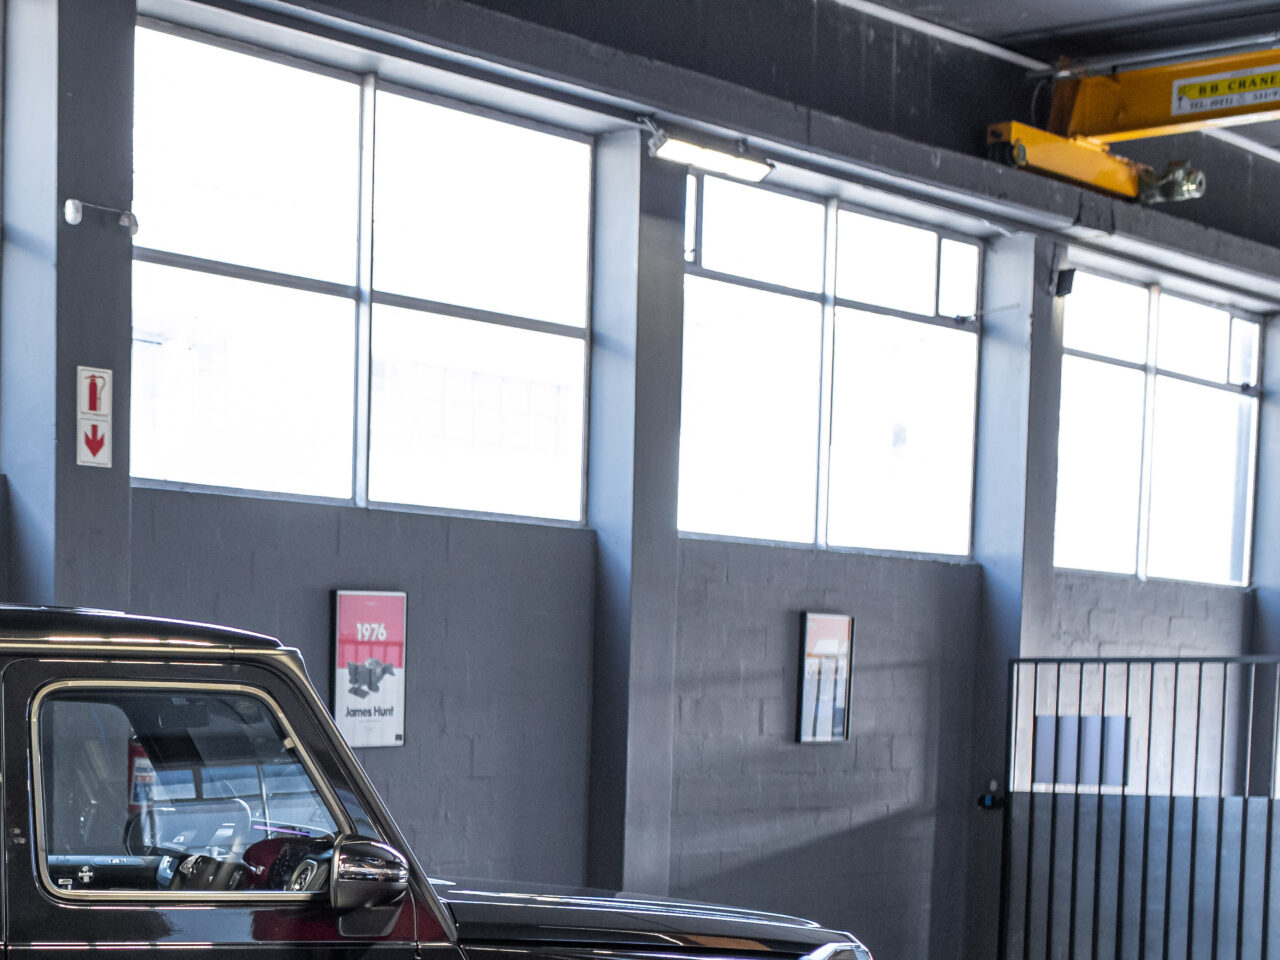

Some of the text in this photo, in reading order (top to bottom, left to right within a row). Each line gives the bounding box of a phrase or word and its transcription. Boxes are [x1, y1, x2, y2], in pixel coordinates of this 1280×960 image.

[356, 622, 387, 641] 1976
[345, 705, 394, 718] James Hunt
